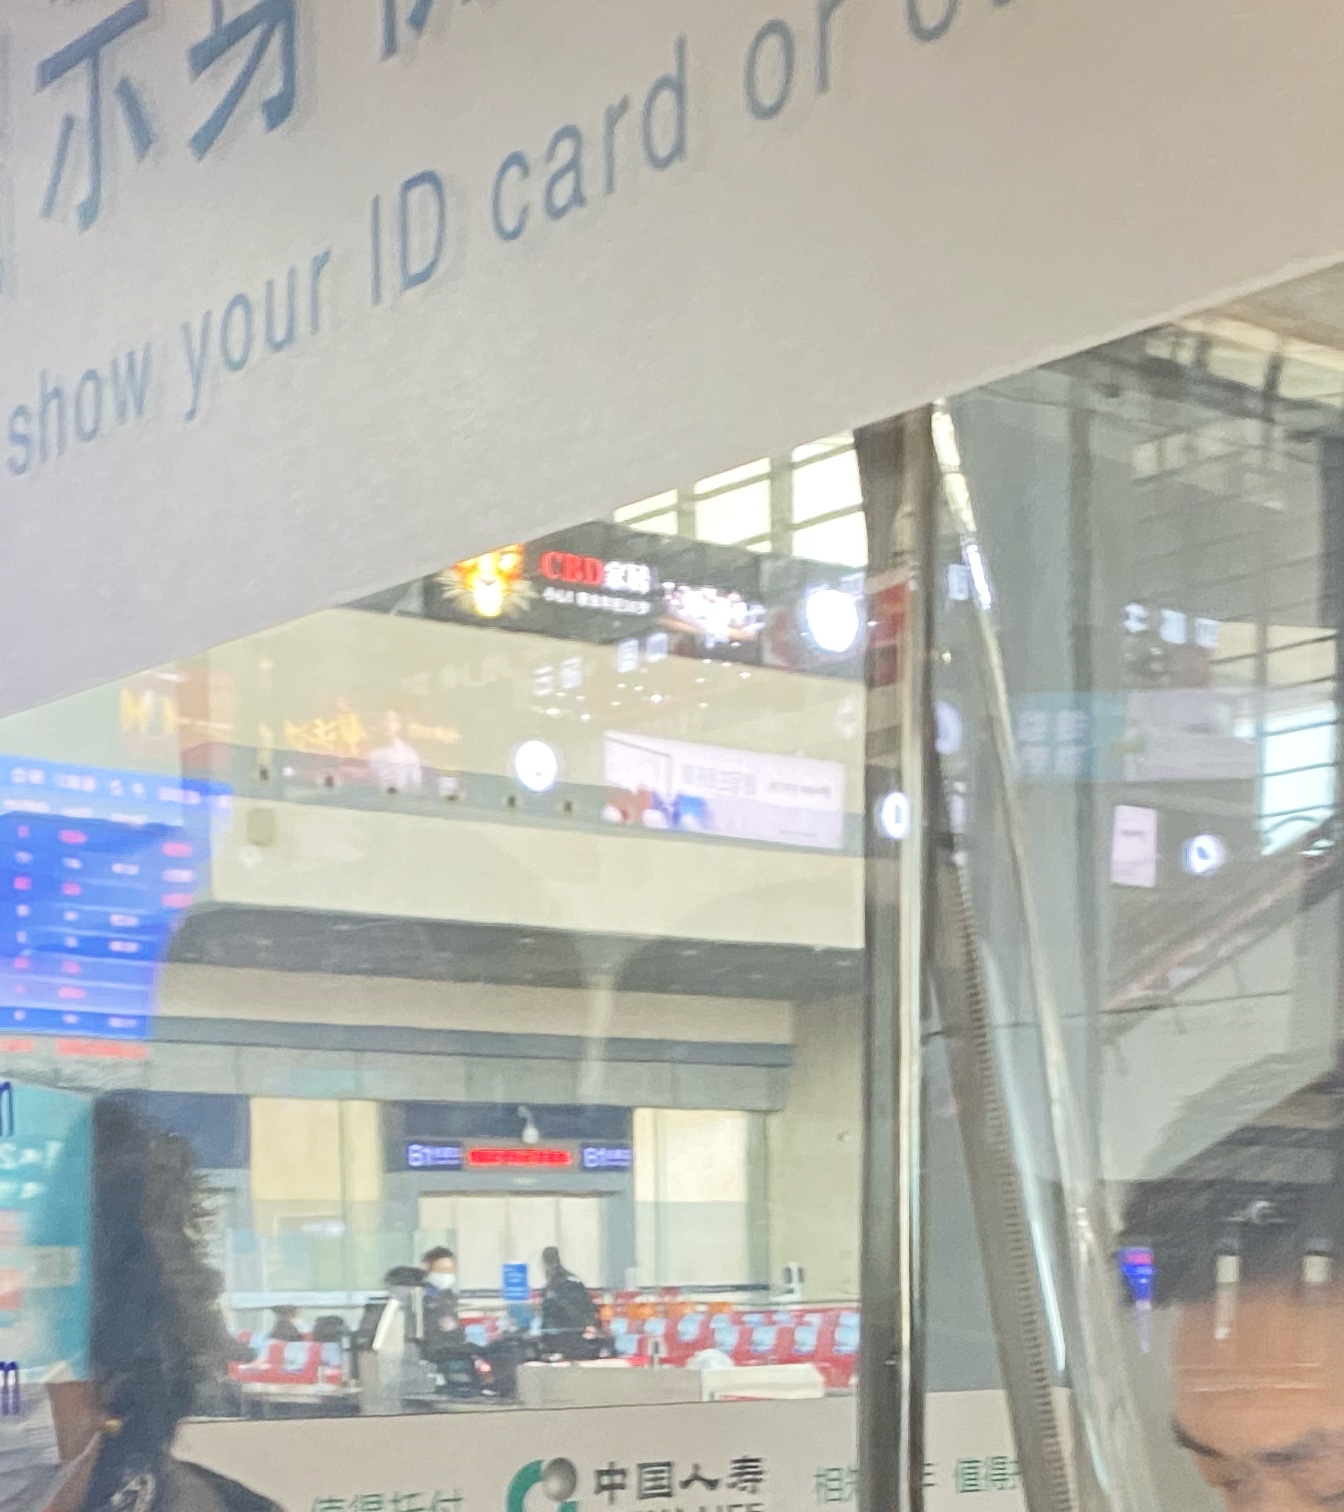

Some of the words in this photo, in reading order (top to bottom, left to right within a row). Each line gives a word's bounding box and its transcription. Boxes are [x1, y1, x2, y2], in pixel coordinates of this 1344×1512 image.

[6, 340, 153, 477] show
[180, 248, 332, 424] your
[372, 168, 448, 308] ID
[490, 33, 688, 245] card
[745, 0, 859, 120] or
[594, 1457, 764, 1505] 中国人寿
